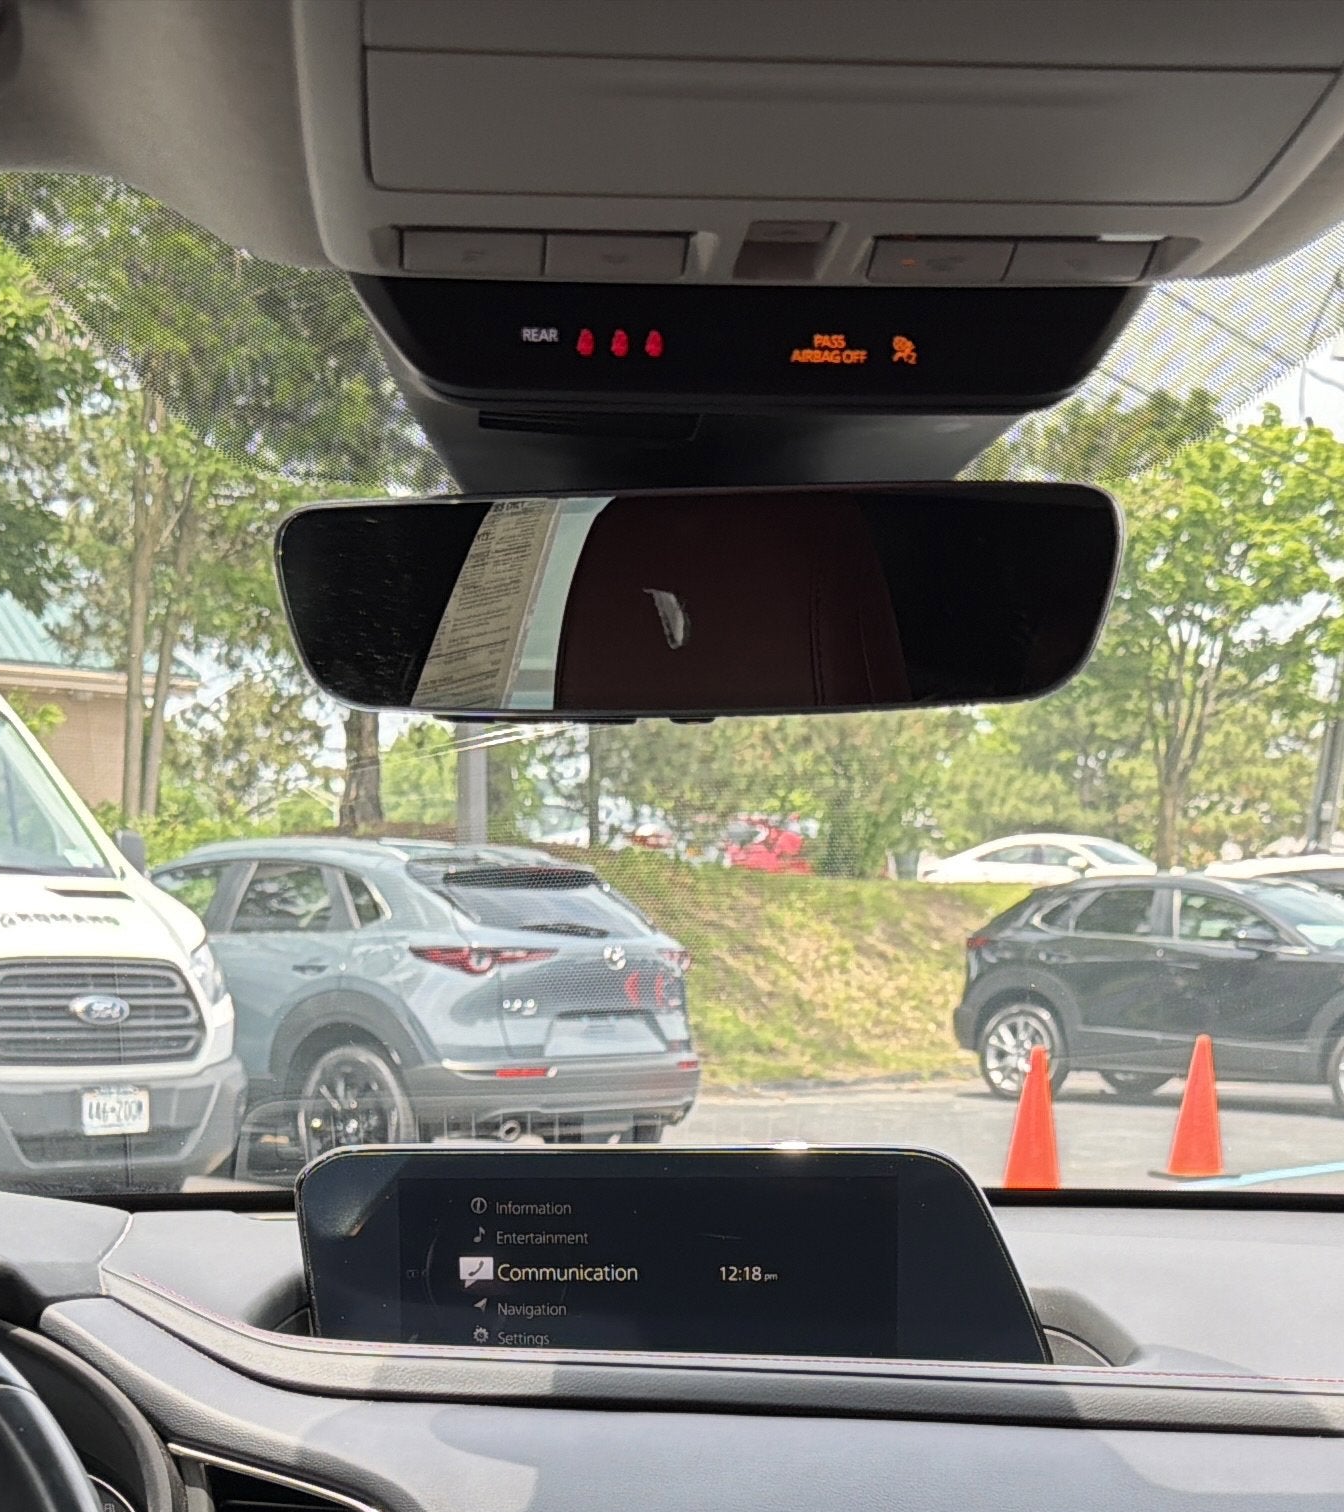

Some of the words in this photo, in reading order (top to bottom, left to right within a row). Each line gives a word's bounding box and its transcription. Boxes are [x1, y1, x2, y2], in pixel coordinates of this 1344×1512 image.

[522, 327, 558, 343] REAR
[813, 334, 846, 349] PASS
[790, 350, 841, 363] AIRBAG
[842, 350, 867, 363] OFF
[496, 1201, 572, 1216] Information
[496, 1230, 588, 1245] Entertainment
[497, 1264, 638, 1282] Communication
[719, 1266, 761, 1281] 12:18
[764, 1273, 778, 1282] pm
[497, 1302, 567, 1320] Navigation
[497, 1331, 550, 1346] Settings
